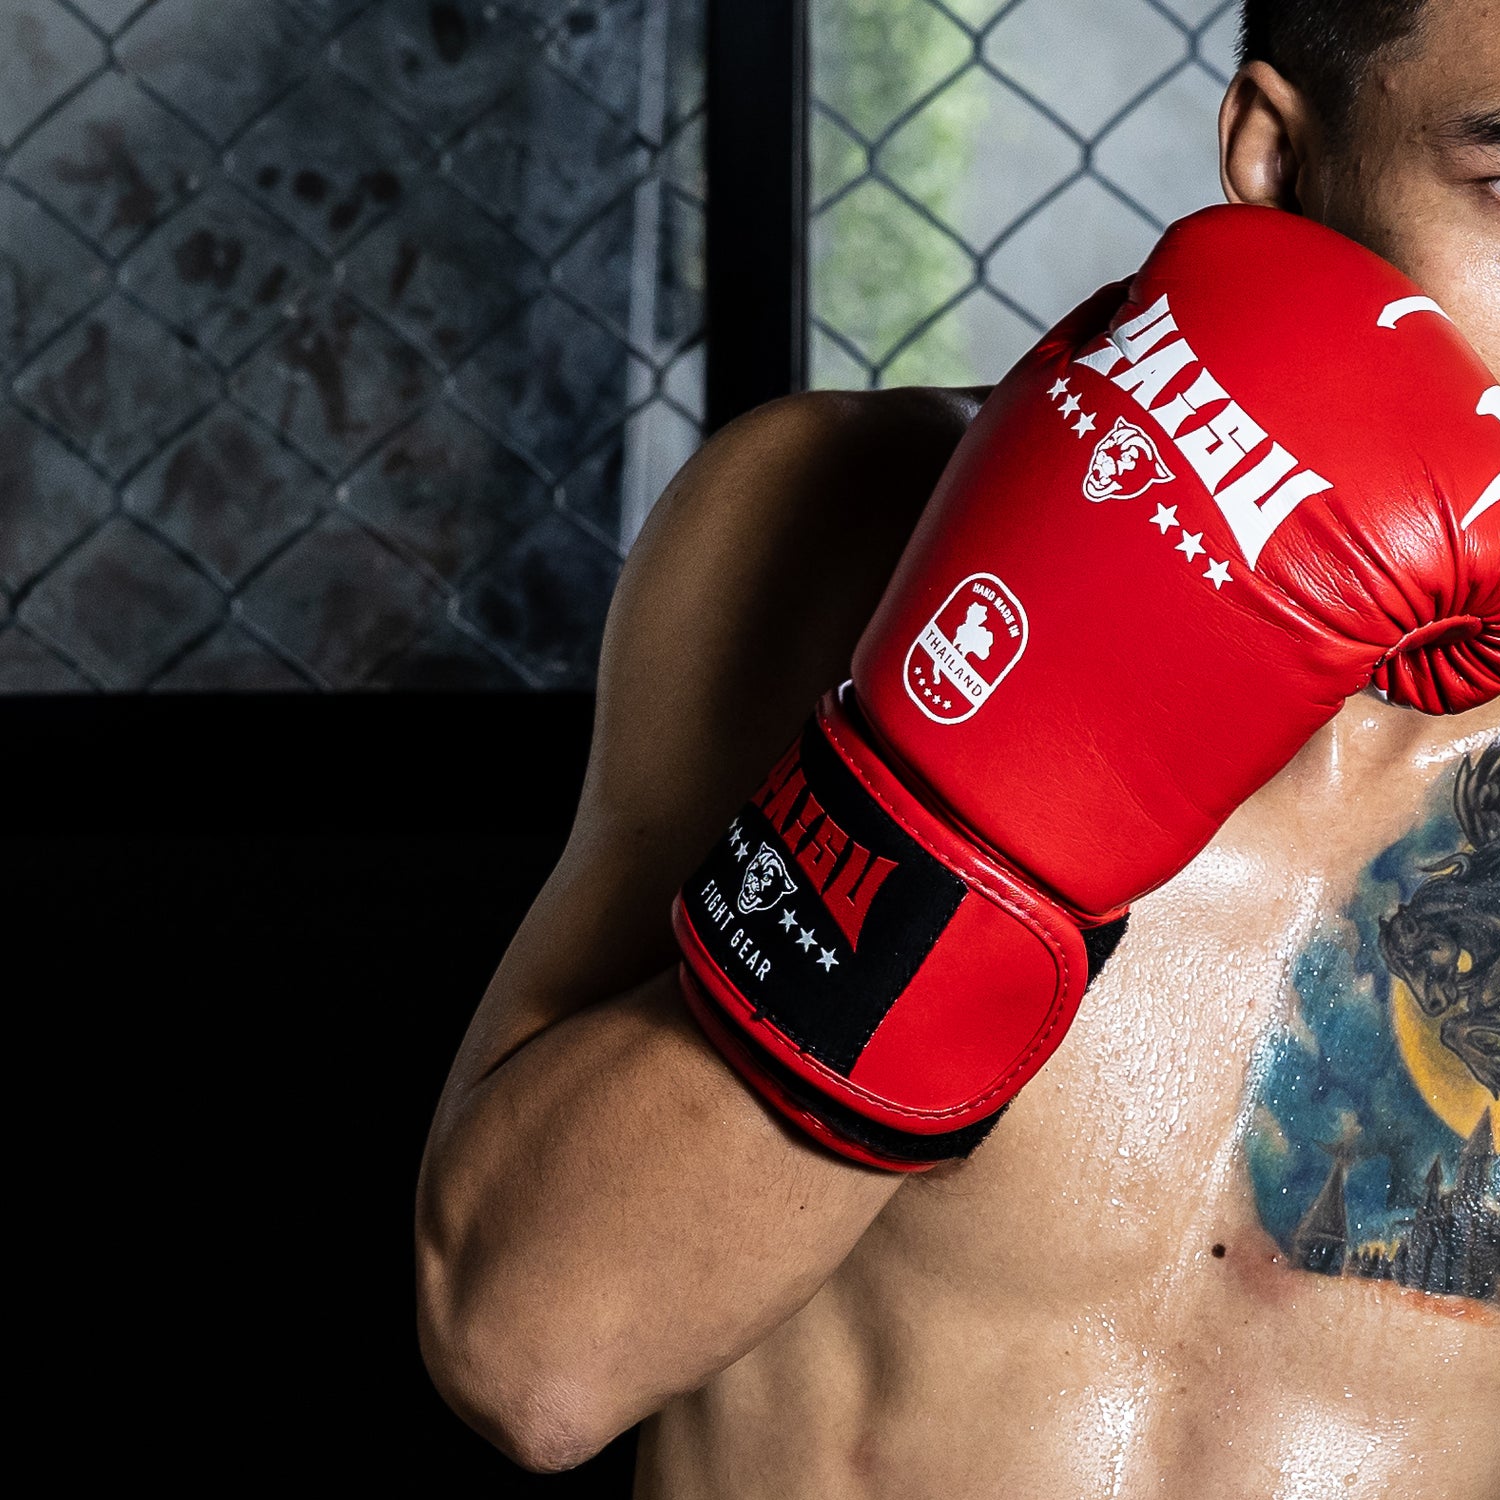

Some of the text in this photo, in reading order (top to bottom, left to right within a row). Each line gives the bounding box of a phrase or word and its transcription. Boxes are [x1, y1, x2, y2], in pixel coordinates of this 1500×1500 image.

[1073, 293, 1334, 572] YAISU
[972, 582, 1021, 638] HAND MADE IN
[925, 629, 982, 697] THAILAND
[700, 879, 771, 981] FIGHT GEAR
